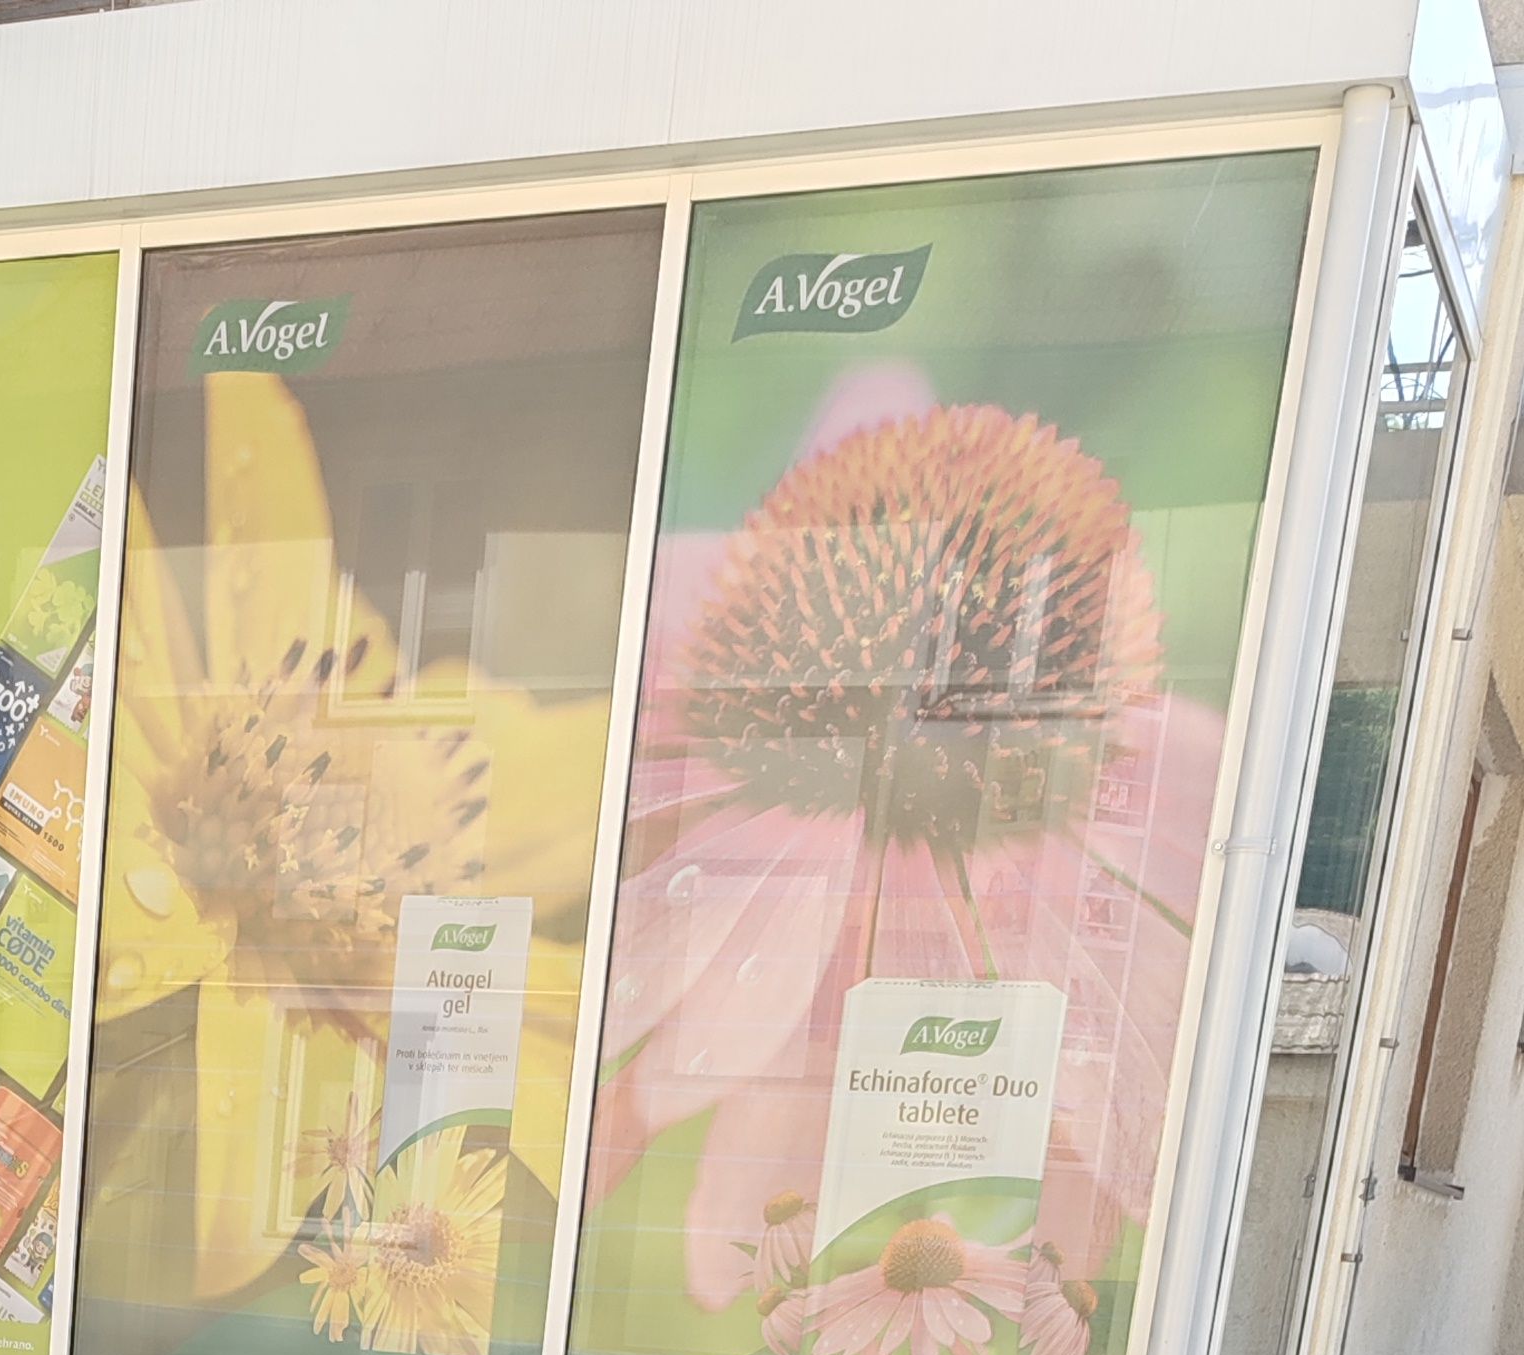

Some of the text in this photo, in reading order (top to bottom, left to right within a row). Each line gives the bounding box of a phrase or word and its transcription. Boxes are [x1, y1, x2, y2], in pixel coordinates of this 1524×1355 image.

[754, 254, 904, 318] A.Vogel
[204, 301, 329, 361] A.Vogel
[9, 789, 44, 820] IMUNO
[6, 915, 55, 960] vitamin
[427, 969, 492, 993] Atrogel
[443, 995, 470, 1018] gel
[912, 1025, 988, 1049] A.Vogel
[992, 1075, 1038, 1098] Duo
[899, 1100, 979, 1126] tablete
